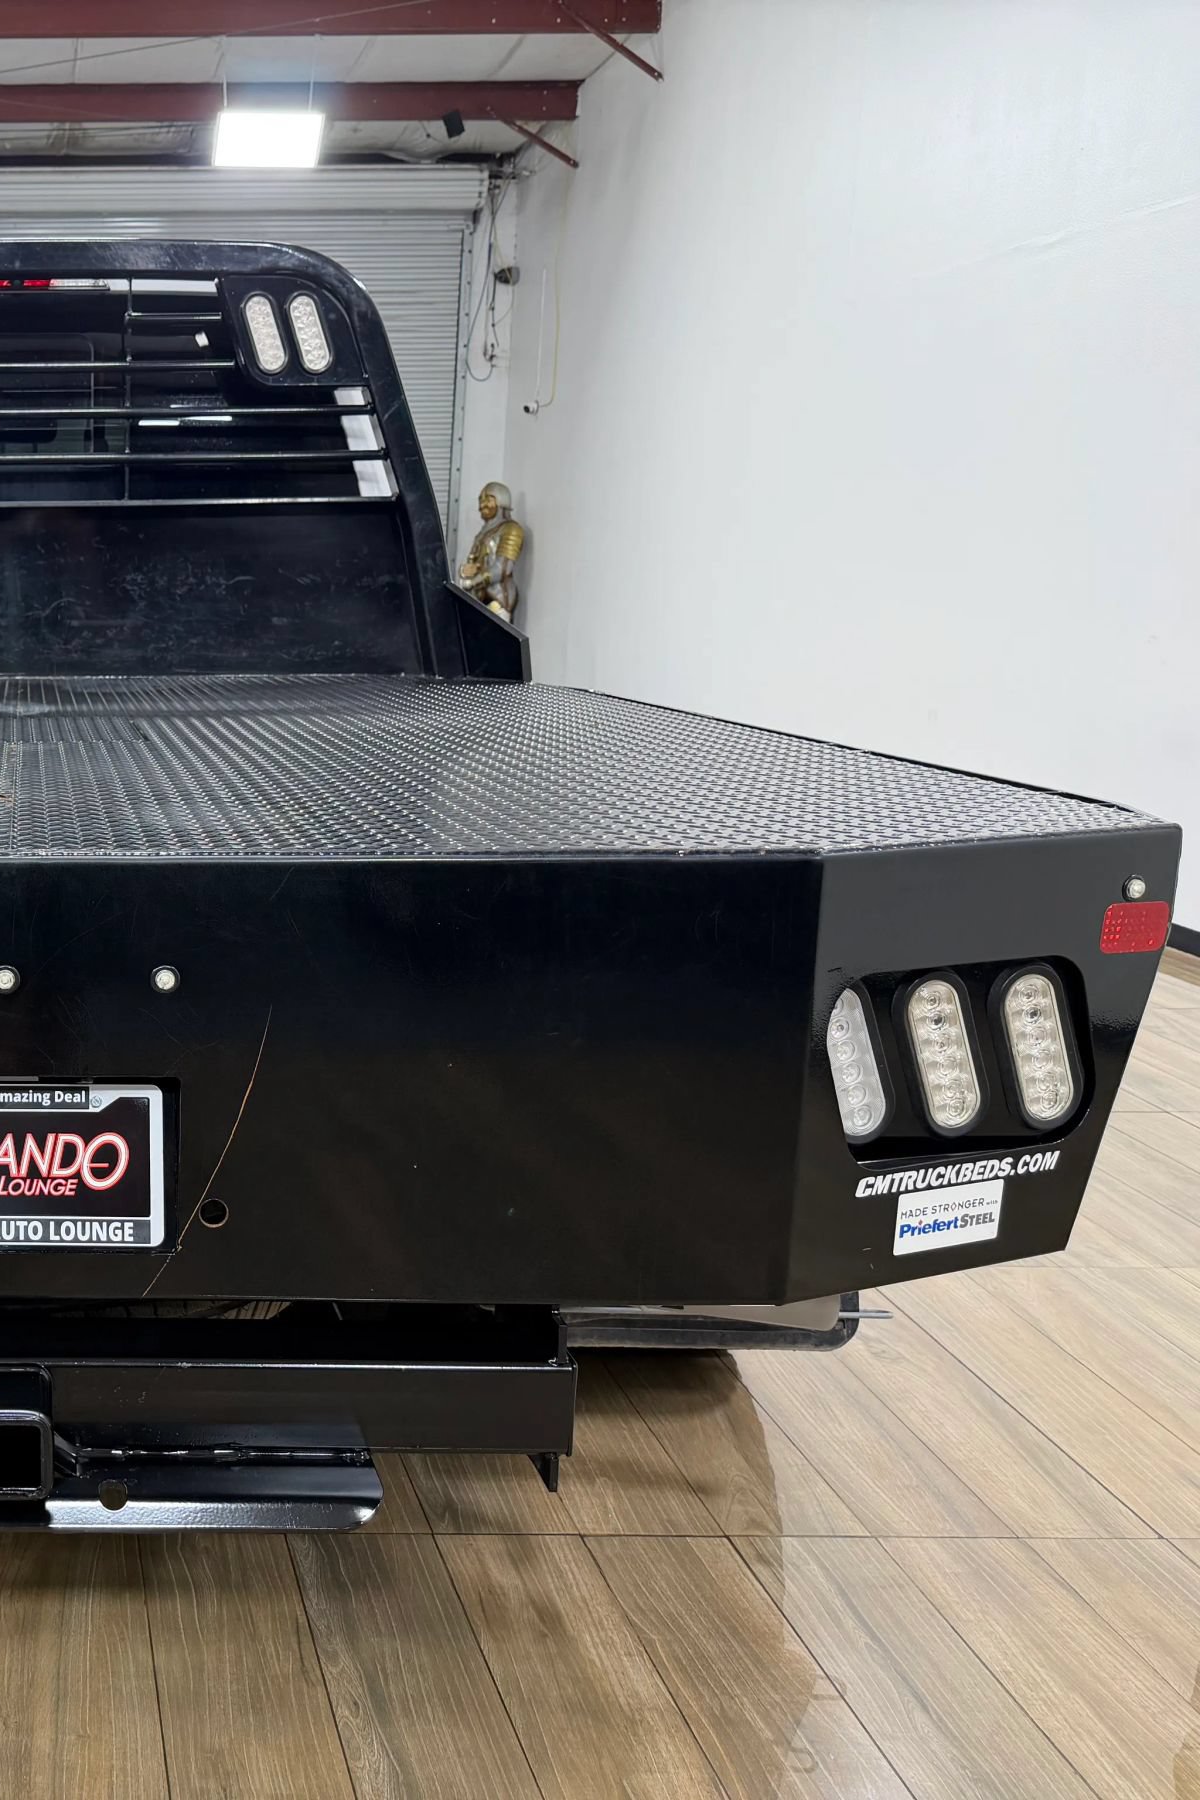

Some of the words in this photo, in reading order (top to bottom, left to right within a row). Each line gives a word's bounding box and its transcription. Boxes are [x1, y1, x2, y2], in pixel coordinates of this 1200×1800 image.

[54, 1090, 86, 1104] Deal
[854, 1150, 1061, 1198] CMTRUCKBEDS.COM
[901, 1207, 929, 1220] MADE
[931, 1197, 985, 1215] STRONGER
[48, 1220, 135, 1242] LOUNGE
